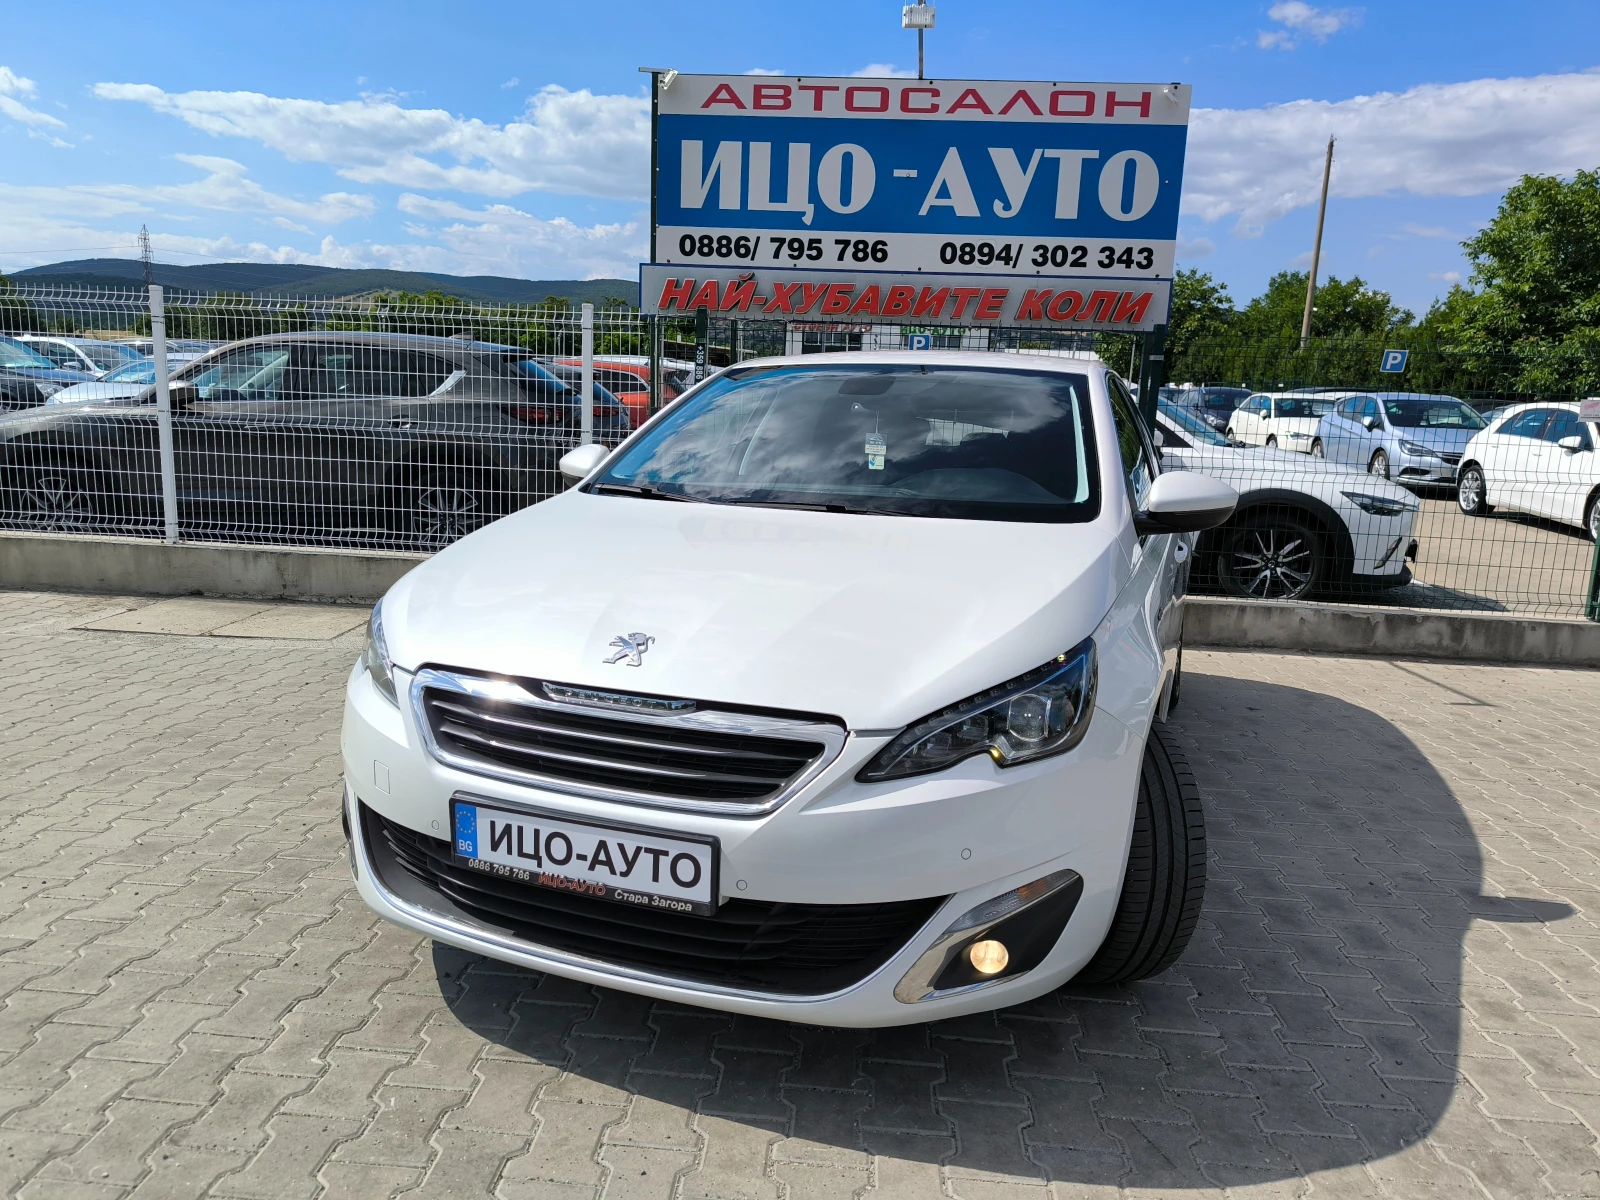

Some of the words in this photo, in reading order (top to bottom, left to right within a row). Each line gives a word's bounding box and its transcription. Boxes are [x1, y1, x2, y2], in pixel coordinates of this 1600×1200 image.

[701, 83, 1152, 118] АВТОСАЛОН
[679, 234, 761, 262] 0886/
[769, 237, 823, 261] 795
[834, 239, 889, 263] 786
[939, 242, 1024, 269] 0894/
[1032, 245, 1088, 268] 302
[1097, 246, 1154, 270] 343
[657, 272, 1009, 320] НАЙ-ХУБАВИТЕ
[1015, 288, 1154, 323] КОЛИ
[913, 336, 926, 350] P
[696, 345, 704, 364] +359
[1385, 352, 1402, 370] P
[695, 365, 704, 380] 886
[458, 839, 473, 852] BG
[489, 820, 702, 888] ИЦО-АУТО
[468, 858, 491, 871] 0886
[493, 864, 510, 876] 795
[512, 868, 530, 881] 786
[538, 871, 606, 896] ИЦО-АУТО
[614, 889, 648, 904] Стара
[651, 895, 692, 911] Загора
